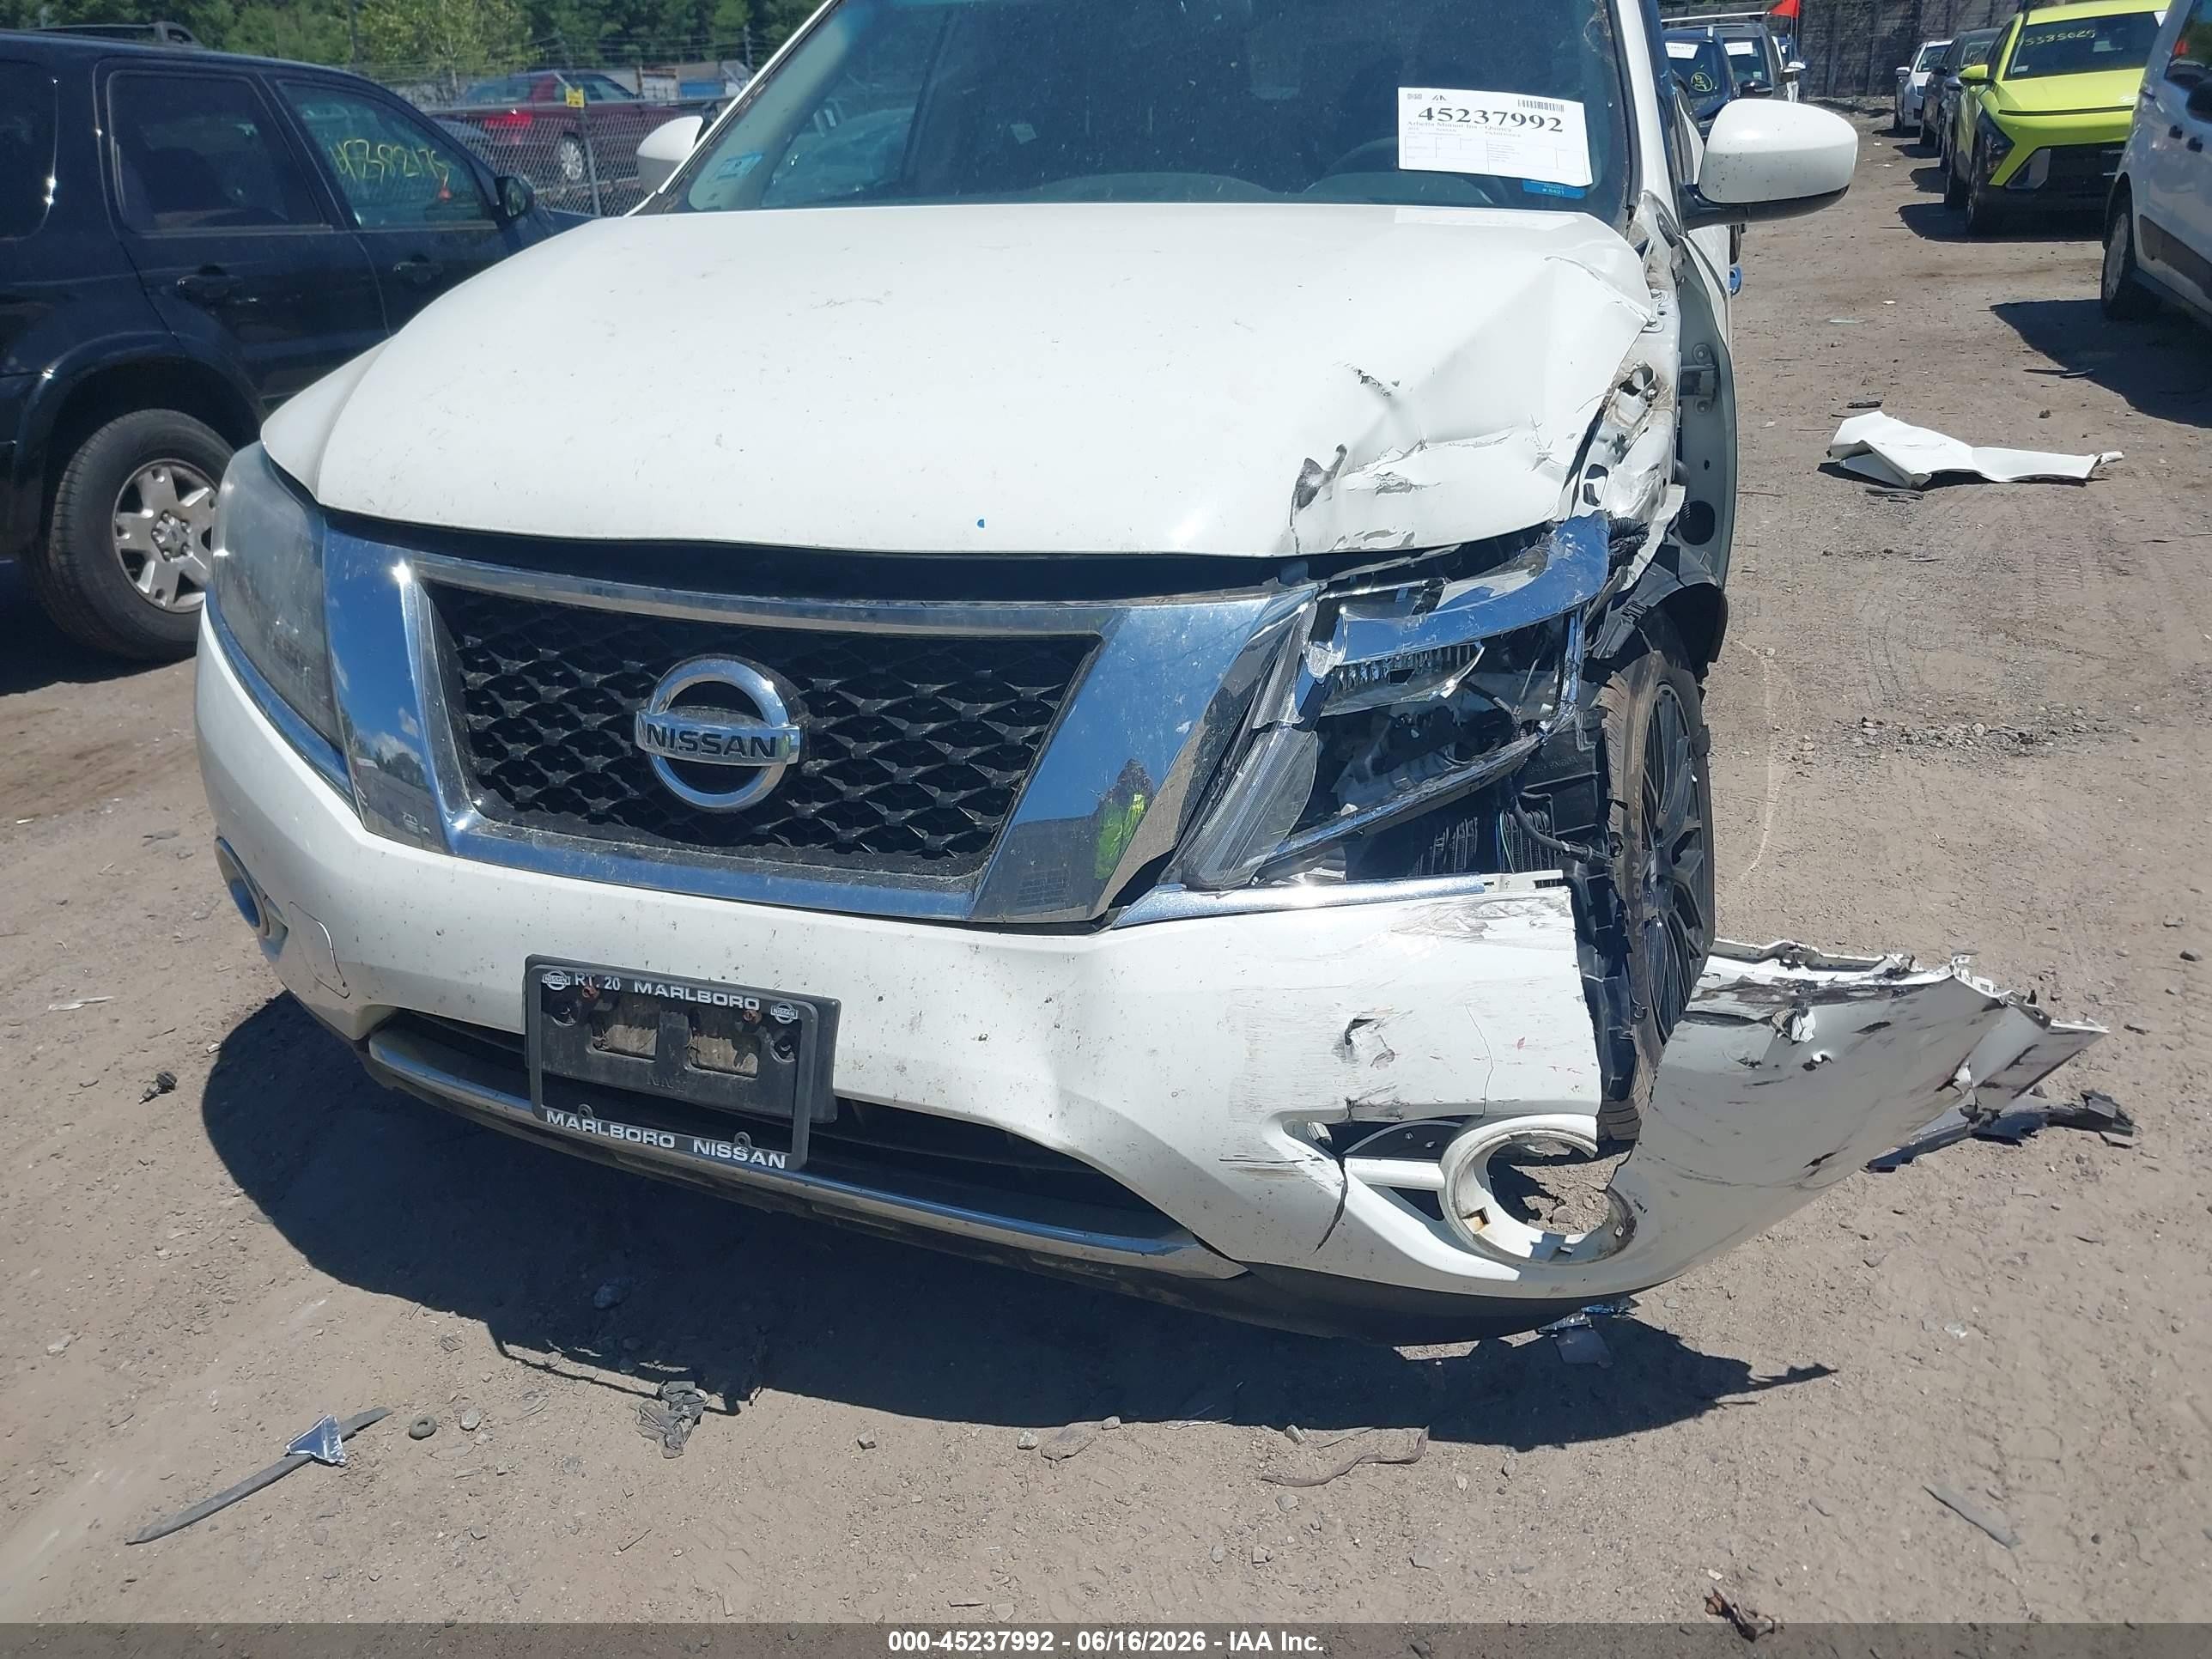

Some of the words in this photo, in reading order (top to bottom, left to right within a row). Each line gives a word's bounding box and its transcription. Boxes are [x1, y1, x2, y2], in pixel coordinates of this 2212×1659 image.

[1418, 106, 1564, 132] 45237992
[646, 723, 777, 759] NISSAN
[604, 975, 621, 991] 20
[634, 980, 760, 1012] MARLBORO
[546, 1110, 676, 1149] MARLBORO
[693, 1139, 787, 1170] NISSAN
